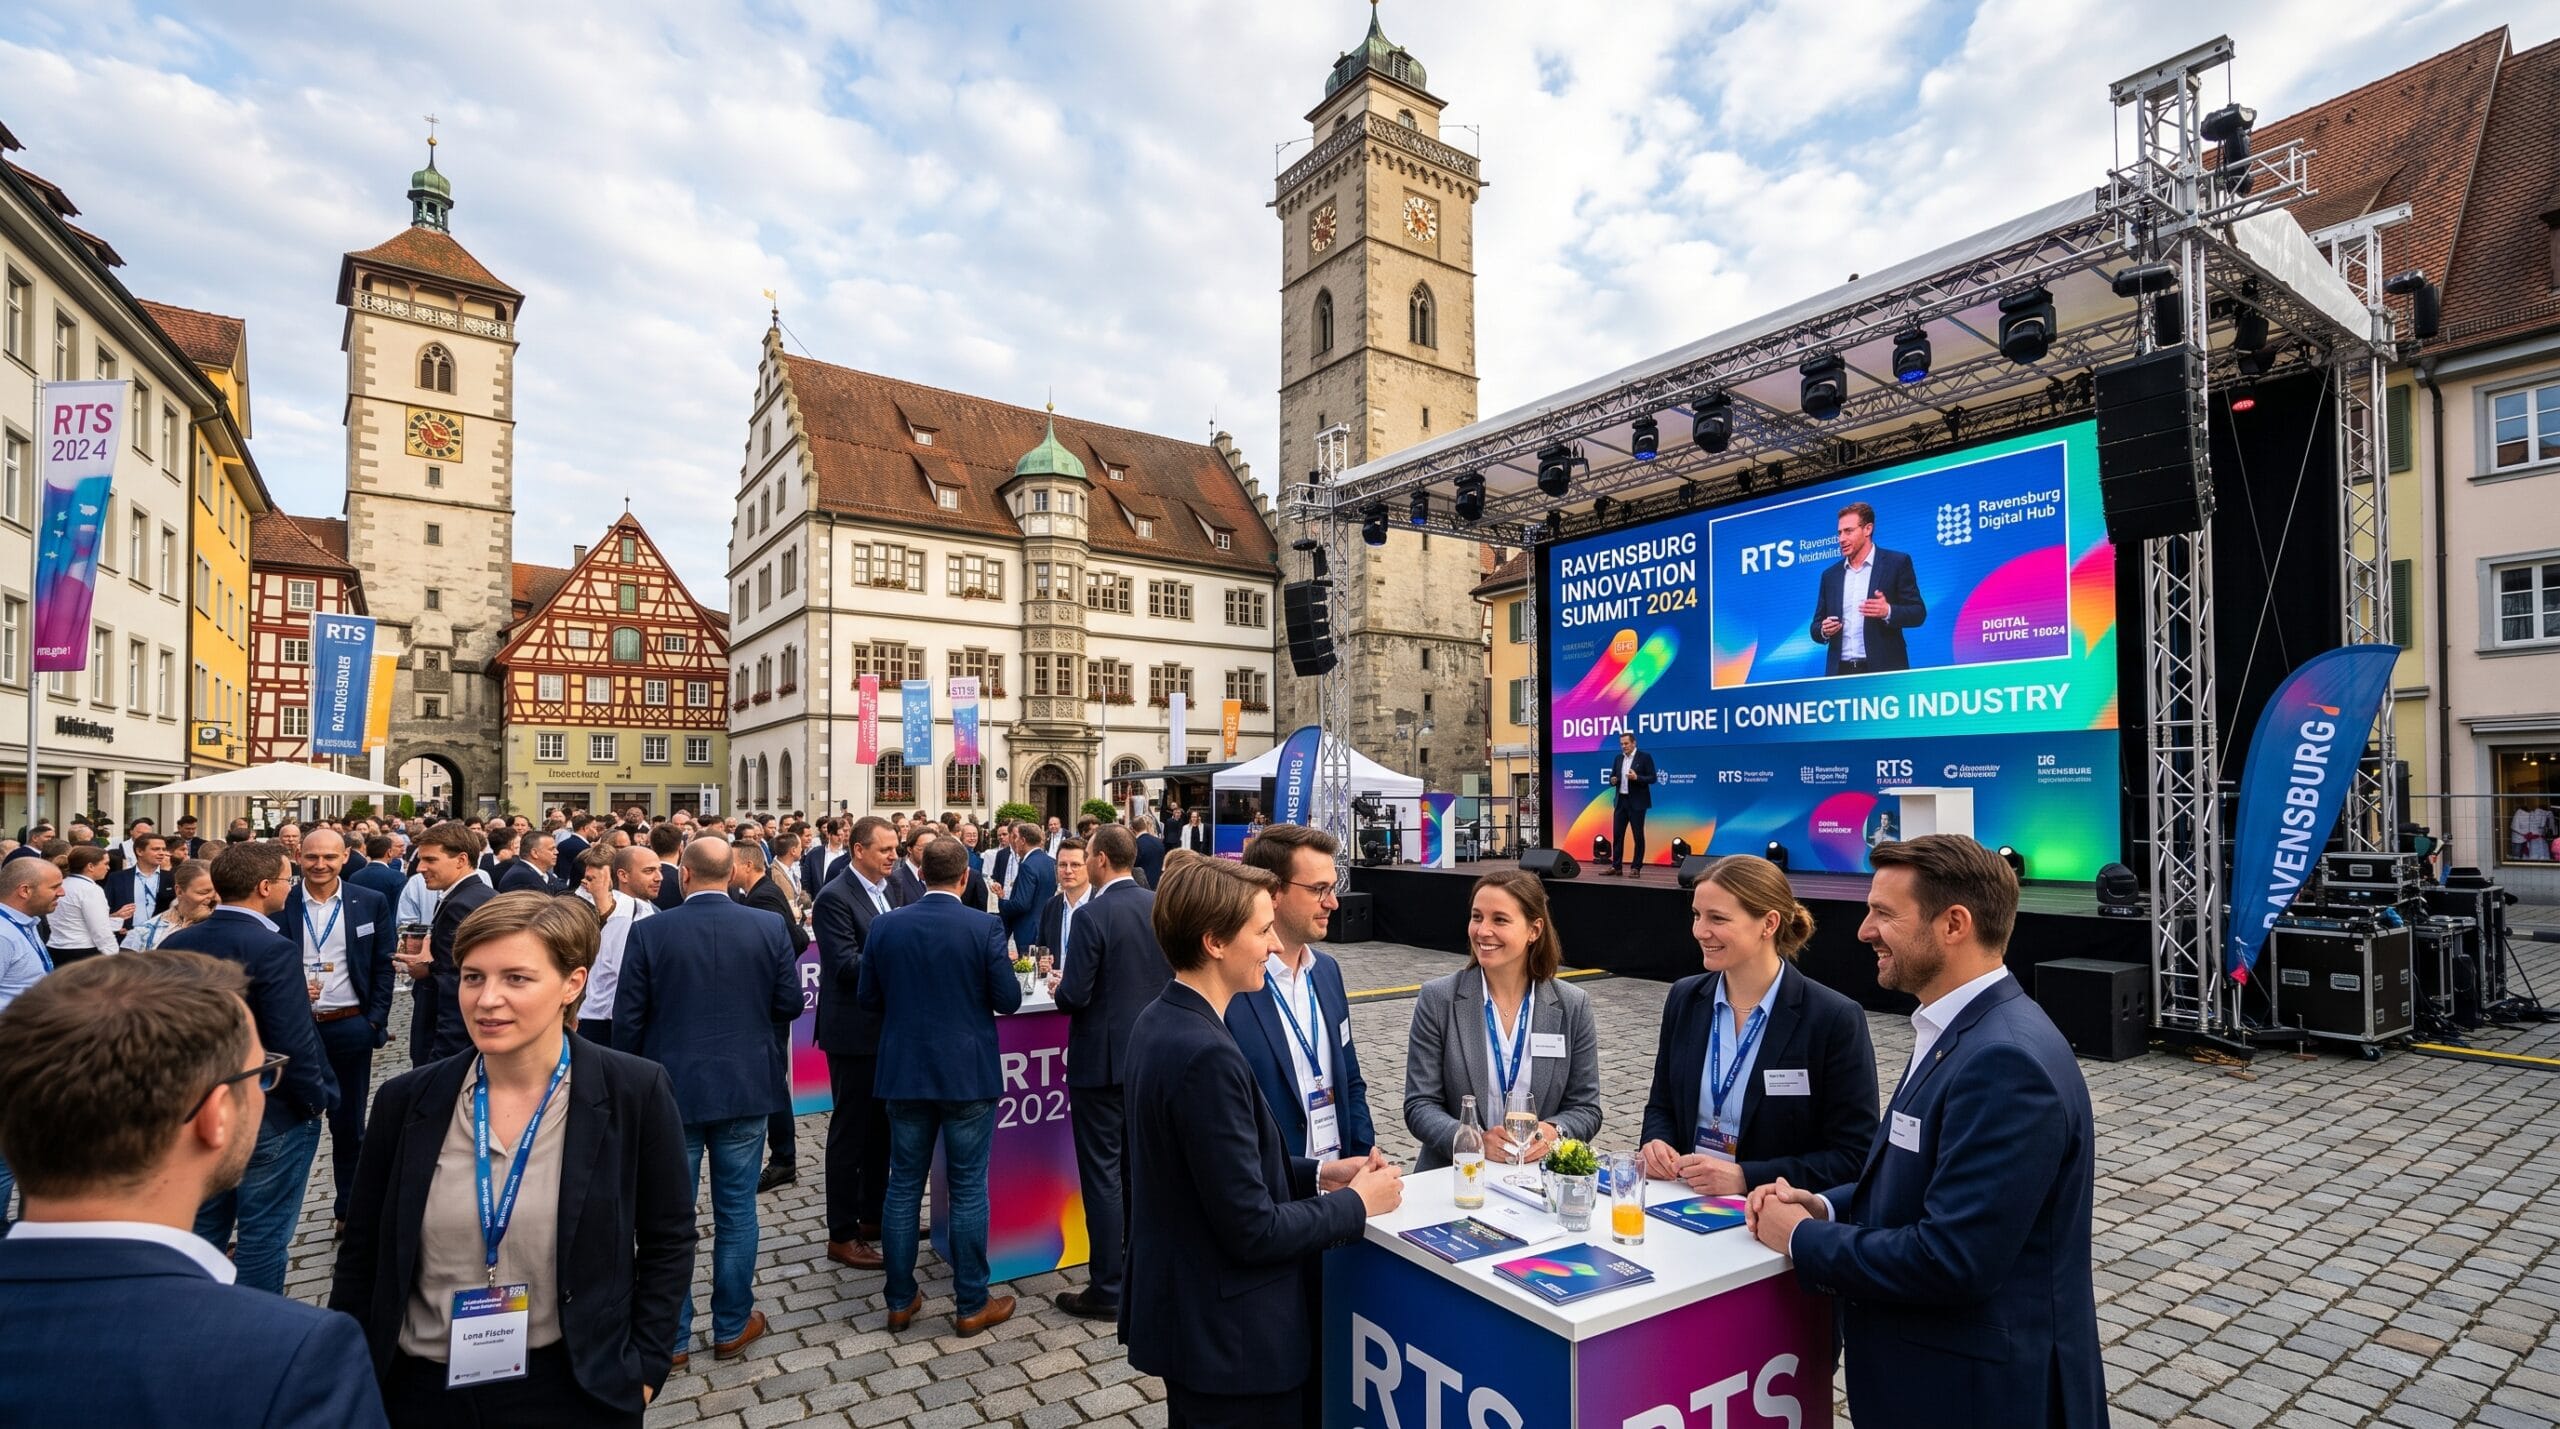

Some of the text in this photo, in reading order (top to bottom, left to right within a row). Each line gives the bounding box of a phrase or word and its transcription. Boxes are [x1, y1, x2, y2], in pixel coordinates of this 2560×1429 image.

[53, 403, 114, 435] RTS
[51, 438, 107, 461] 2024
[1978, 489, 2061, 513] Ravensburg
[1978, 504, 2056, 530] Digital Hub
[1561, 532, 1697, 578] RAVENSBURG
[1741, 540, 1795, 575] RTS
[1561, 559, 1697, 604] INNOVATION
[1561, 587, 1698, 628] SUMMIT 2024
[326, 622, 367, 642] RTS
[1982, 616, 2029, 630] DIGITAL
[1982, 628, 2029, 643] FUTURE
[1562, 715, 1635, 738] DIGITAL
[1638, 708, 1718, 734] FUTURE
[1735, 695, 1899, 728] CONNECTING
[1908, 682, 2071, 718] INDUSTRY
[1718, 771, 1742, 783] RTS
[1876, 759, 1913, 777] RTS
[997, 1090, 1072, 1129] 202
